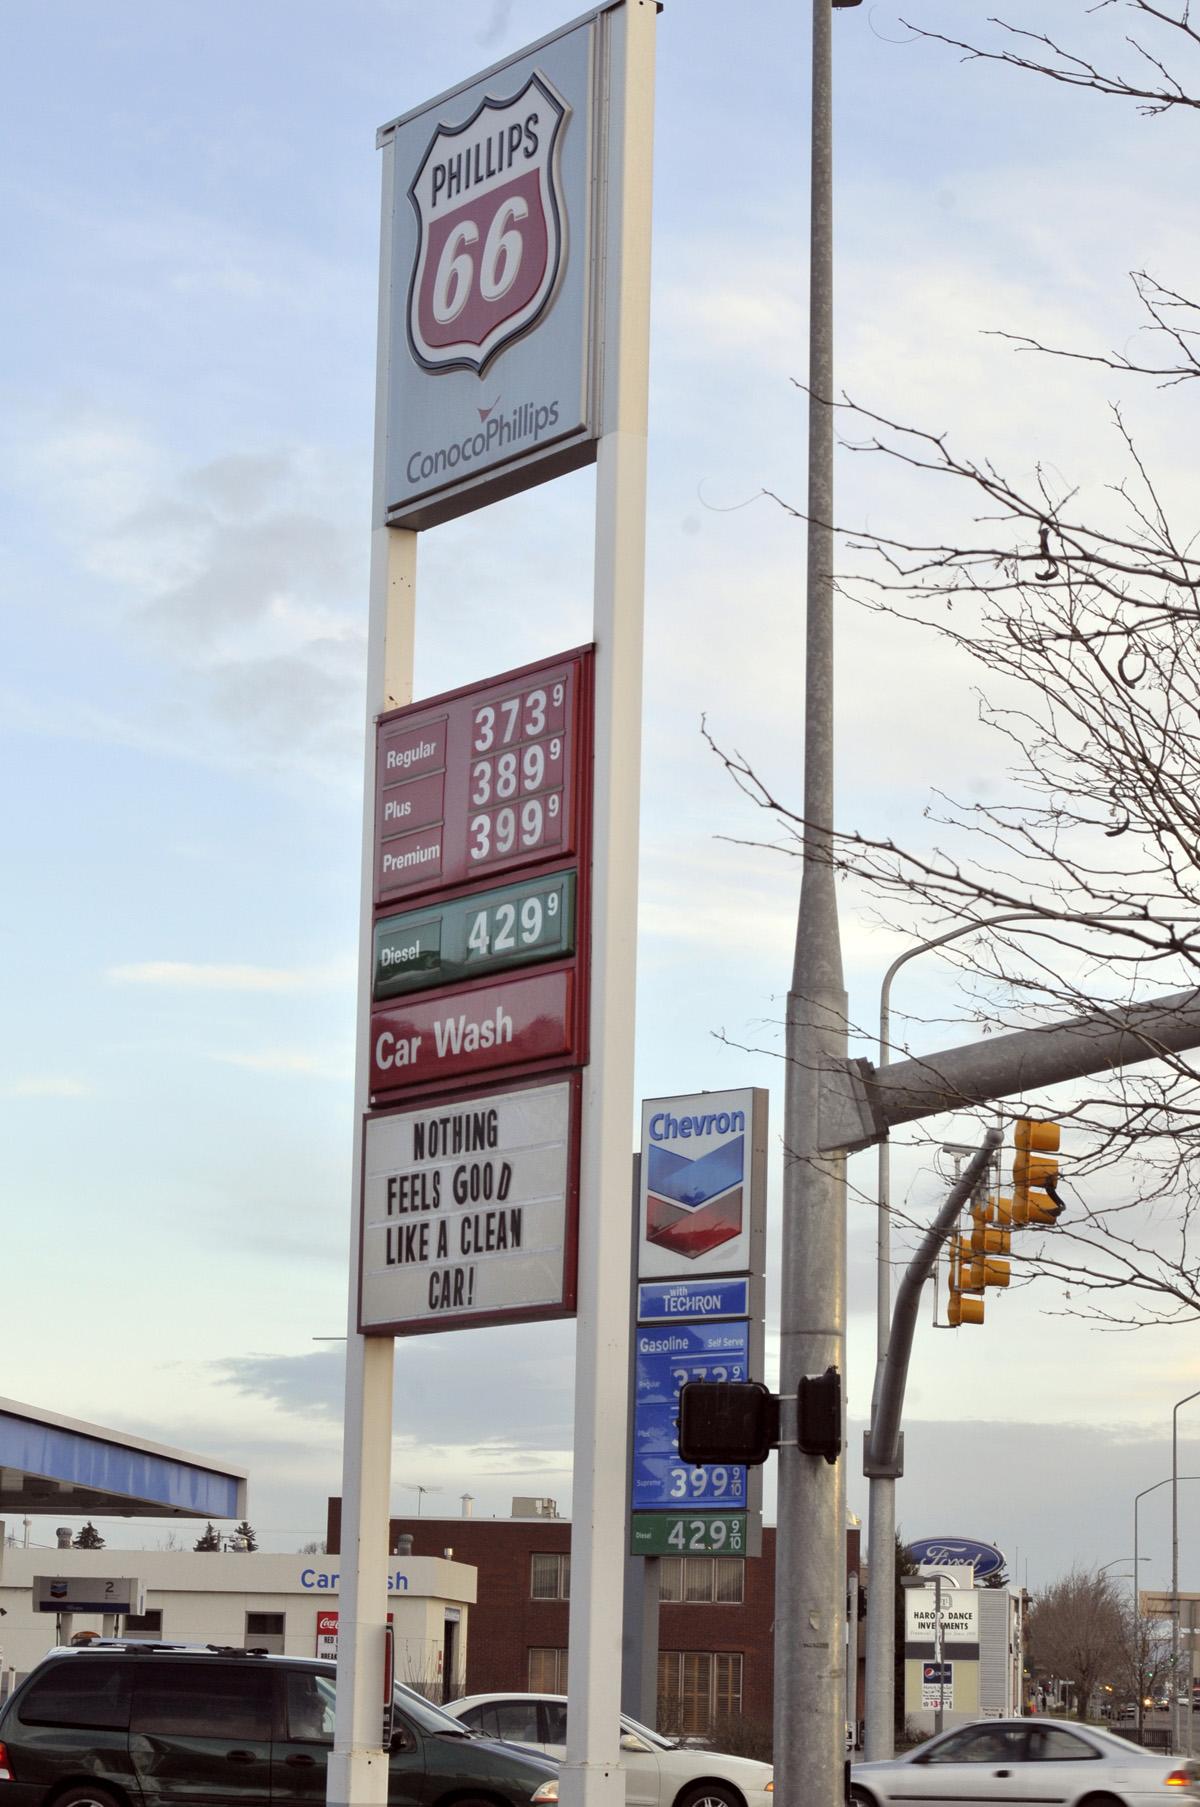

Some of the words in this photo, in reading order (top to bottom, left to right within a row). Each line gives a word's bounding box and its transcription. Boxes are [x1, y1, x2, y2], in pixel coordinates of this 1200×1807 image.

[432, 112, 540, 207] PHILLIPS
[432, 196, 529, 325] 66
[406, 400, 560, 484] ConocoPhillips
[387, 740, 437, 769] Regular
[384, 801, 411, 820] Plus
[383, 844, 440, 872] Premium
[381, 940, 420, 968] Diesel
[375, 1031, 422, 1070] Car
[434, 1006, 513, 1058] Wash
[414, 1109, 498, 1161] NOTHING
[649, 1110, 745, 1141] Chevron
[387, 1170, 440, 1215] FEELS
[453, 1161, 512, 1205] GOOD
[386, 1222, 428, 1265] LIKE
[437, 1219, 448, 1259] A
[460, 1208, 522, 1255] CLEAN
[428, 1266, 474, 1310] CAR!
[669, 1286, 688, 1297] with
[640, 1336, 689, 1352] Gasoline
[707, 1338, 721, 1348] Self
[723, 1338, 744, 1347] Serve
[667, 1520, 727, 1549] 429
[105, 1581, 114, 1593] 2
[301, 1569, 340, 1588] Car
[387, 1571, 408, 1590] sh
[914, 1612, 944, 1620] HAROD
[948, 1612, 973, 1620] DANCE
[918, 1622, 969, 1630] INVEMENTS
